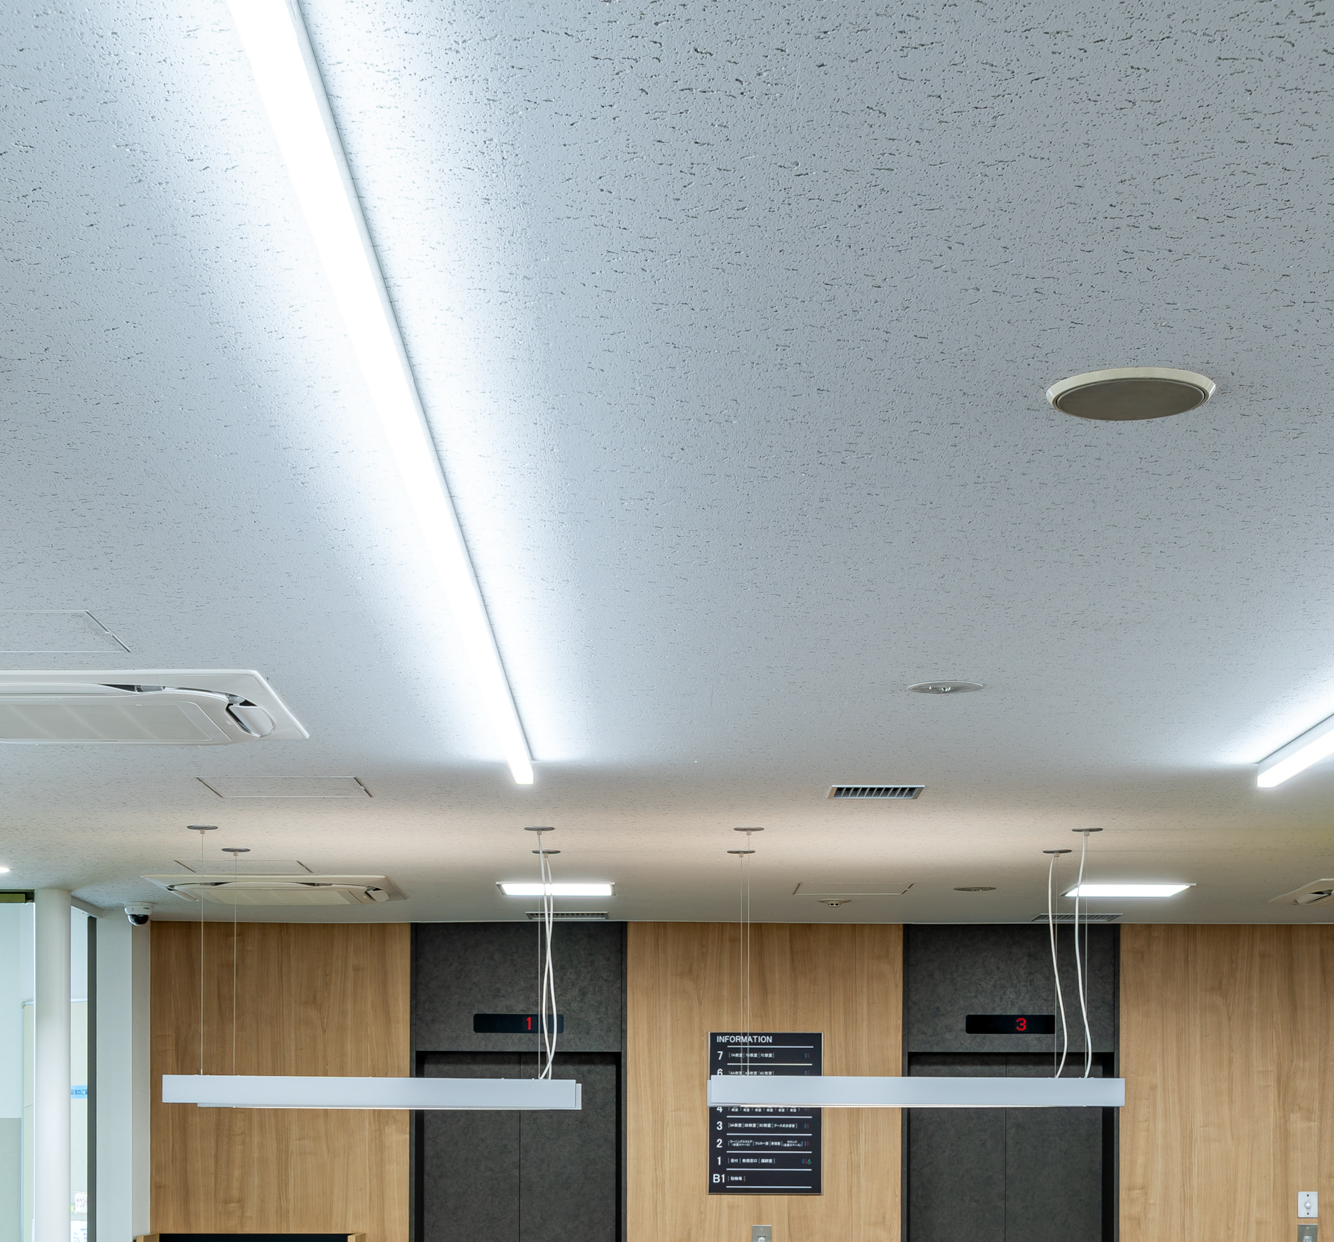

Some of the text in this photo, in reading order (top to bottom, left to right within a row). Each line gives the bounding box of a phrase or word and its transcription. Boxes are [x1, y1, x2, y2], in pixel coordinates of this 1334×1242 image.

[526, 1017, 531, 1030] 1
[1016, 1017, 1027, 1031] 3
[716, 1035, 773, 1043] INFORMATION
[717, 1051, 723, 1060] 7
[717, 1068, 723, 1076] 6
[716, 1121, 723, 1130] 3
[716, 1138, 723, 1148] 2
[717, 1156, 722, 1165] 1
[713, 1173, 725, 1183] B1
